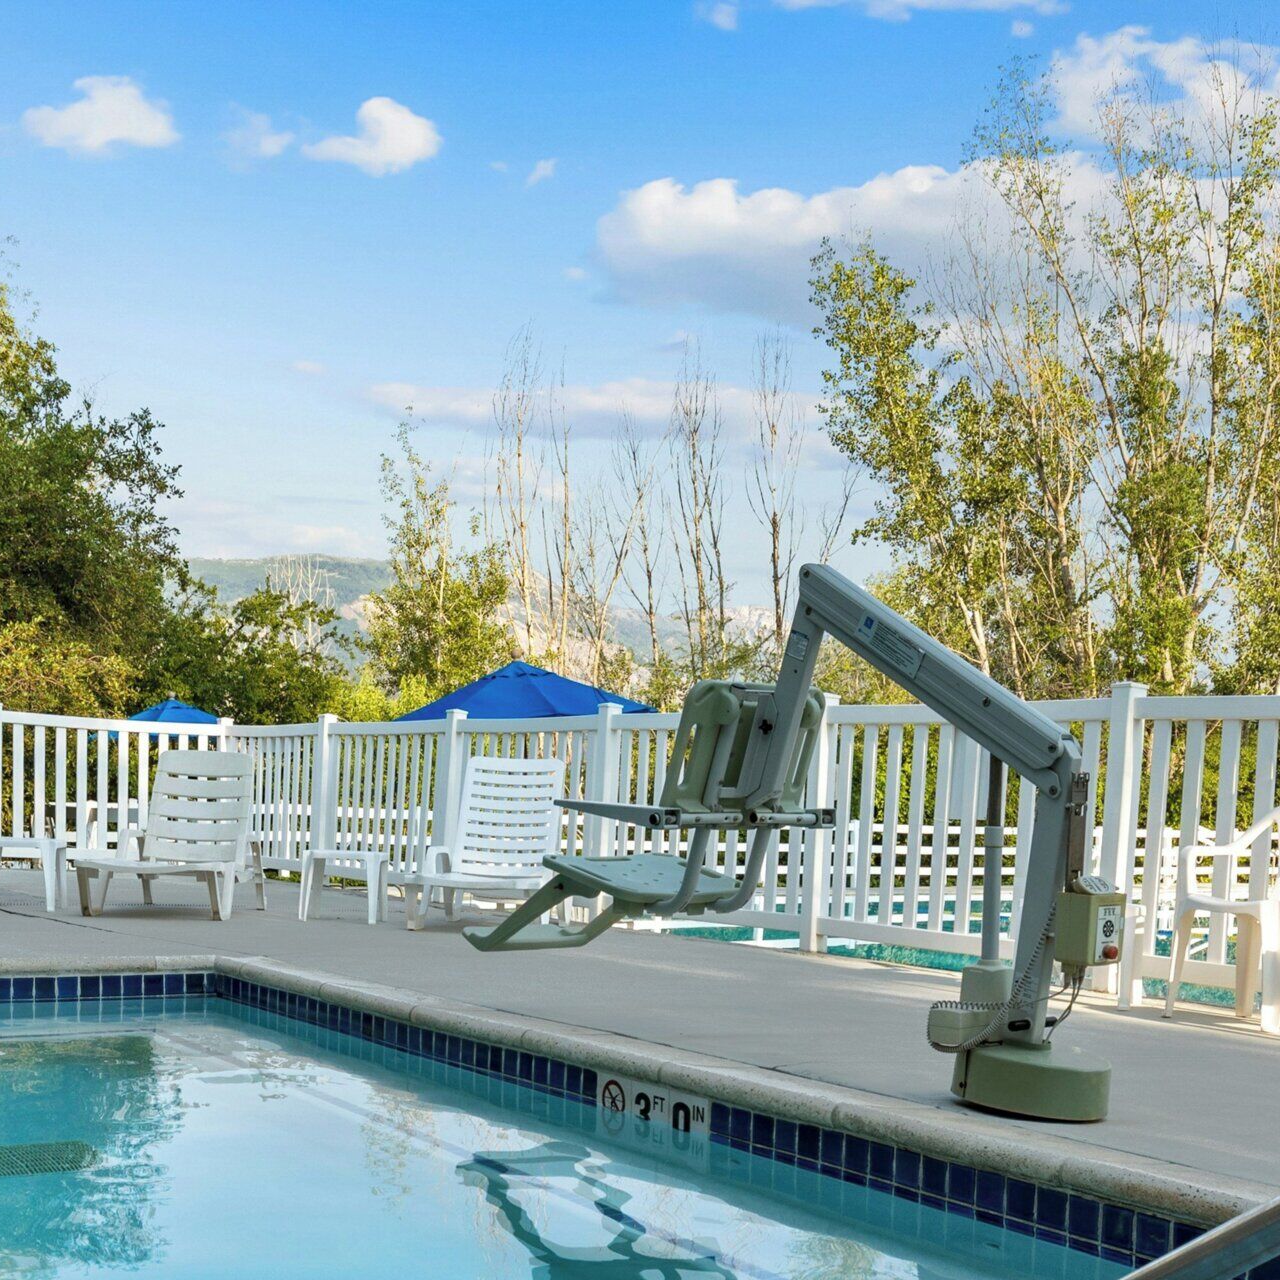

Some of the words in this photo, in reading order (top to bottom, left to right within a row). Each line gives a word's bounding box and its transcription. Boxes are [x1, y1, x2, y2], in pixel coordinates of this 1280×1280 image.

[635, 1092, 651, 1121] 3
[653, 1095, 666, 1113] FT
[672, 1101, 691, 1133] 0
[692, 1104, 705, 1123] IN
